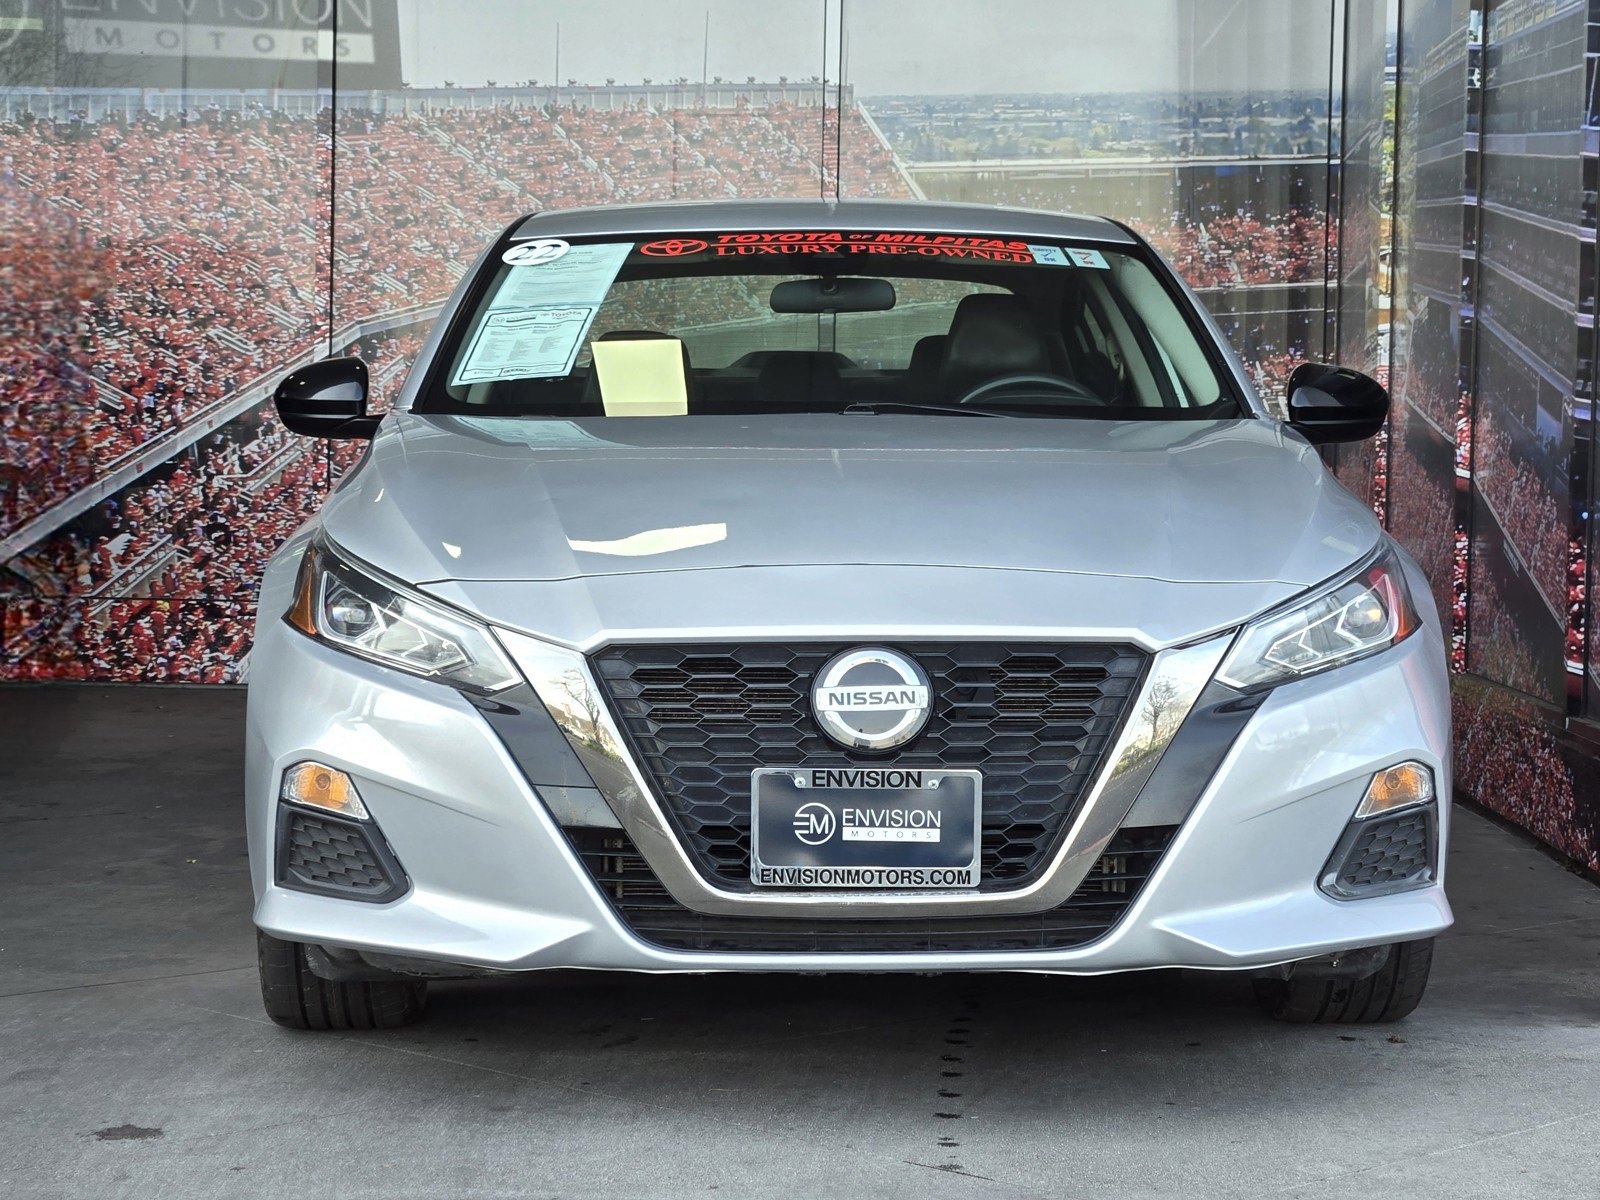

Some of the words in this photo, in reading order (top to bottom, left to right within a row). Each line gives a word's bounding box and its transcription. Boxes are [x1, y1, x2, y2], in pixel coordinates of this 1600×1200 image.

[95, 27, 350, 57] MOTORS
[718, 233, 842, 243] TOYOTA
[876, 233, 1028, 250] MILPITAS
[509, 244, 561, 261] 22
[716, 244, 841, 256] LUXURY
[850, 244, 1033, 264] PRE-OWNED
[829, 690, 916, 706] NISSAN
[812, 770, 922, 788] ENVISION
[842, 808, 941, 828] ENVISION
[850, 831, 932, 839] MOTORS
[760, 868, 971, 885] ENVISIONMOTORS.COM
